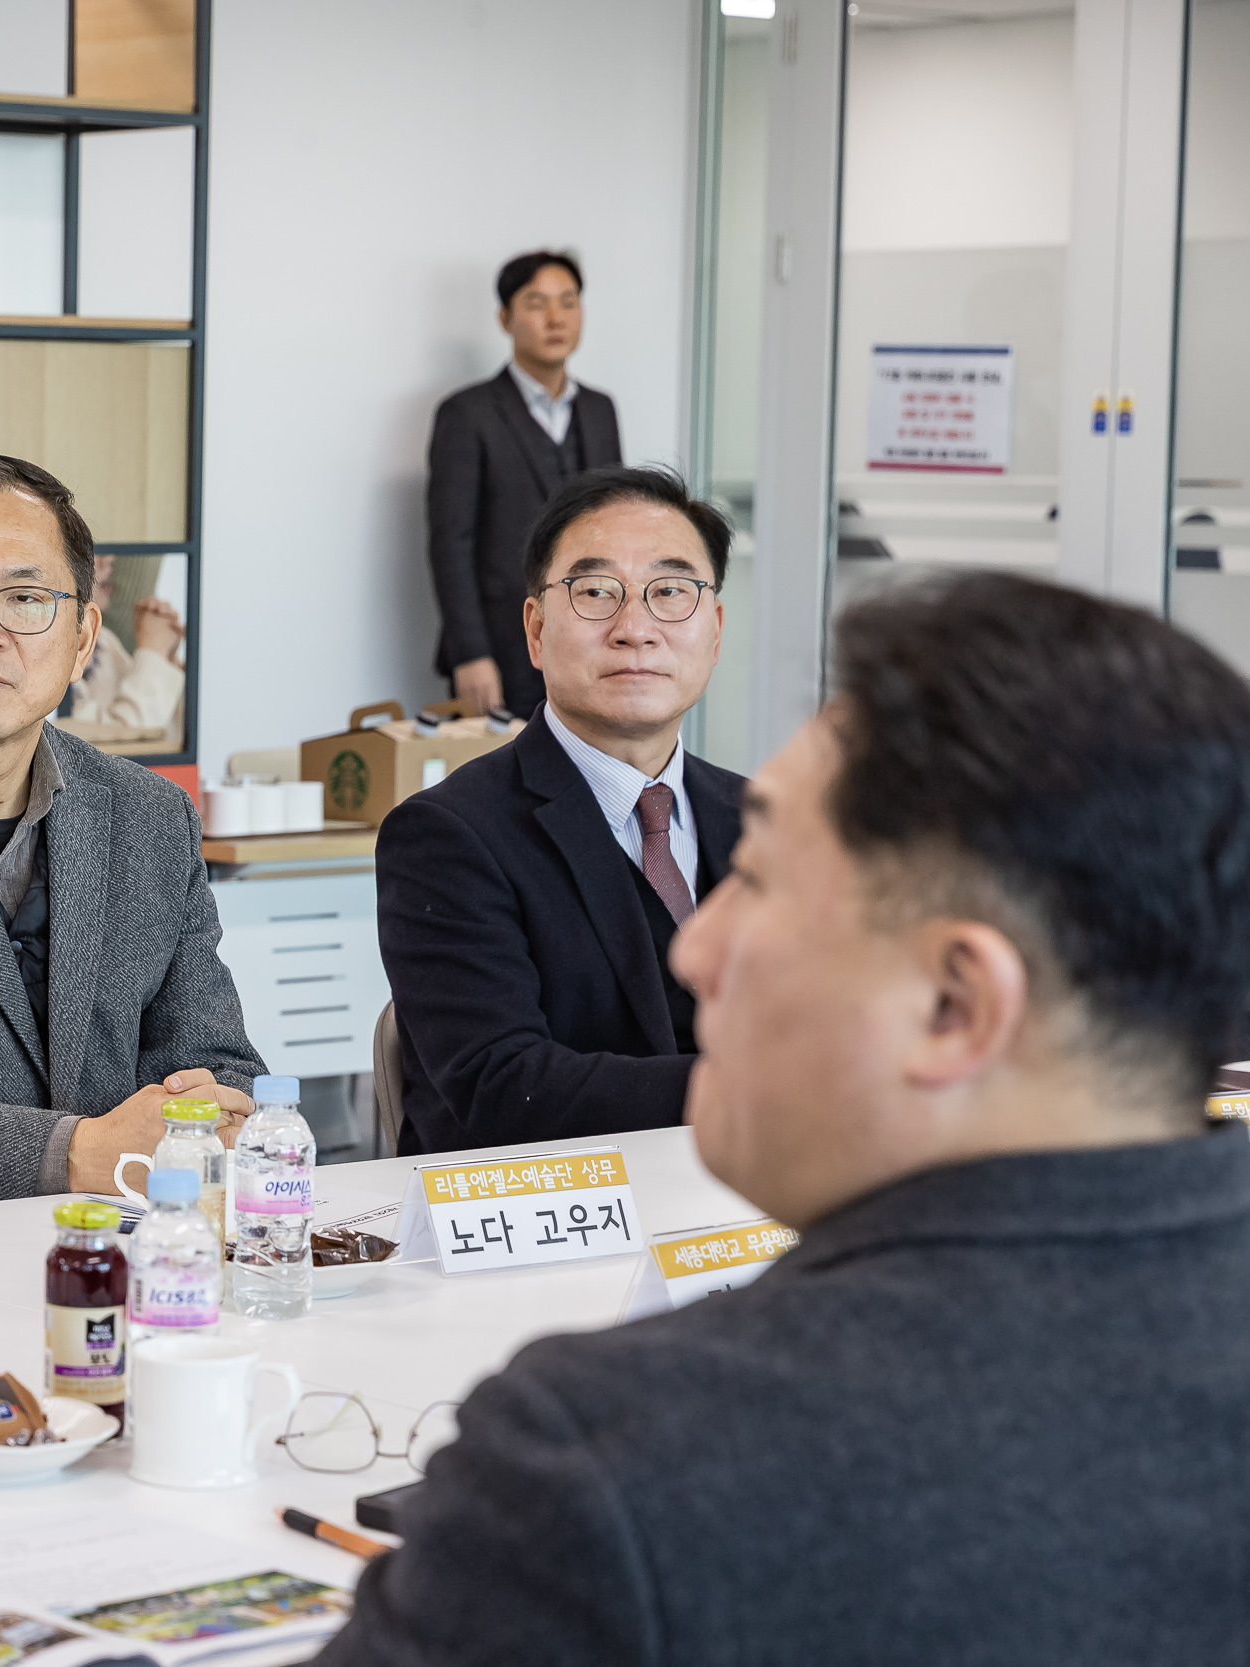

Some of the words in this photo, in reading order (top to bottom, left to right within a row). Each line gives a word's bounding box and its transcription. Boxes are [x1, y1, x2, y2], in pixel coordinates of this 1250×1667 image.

[265, 1179, 311, 1195] 아이시스
[435, 1162, 574, 1199] 리틀엔젤스예술단
[581, 1159, 617, 1185] 상무
[450, 1210, 514, 1254] 노다
[535, 1198, 631, 1246] 고우지
[674, 1238, 745, 1269] 세종대학교
